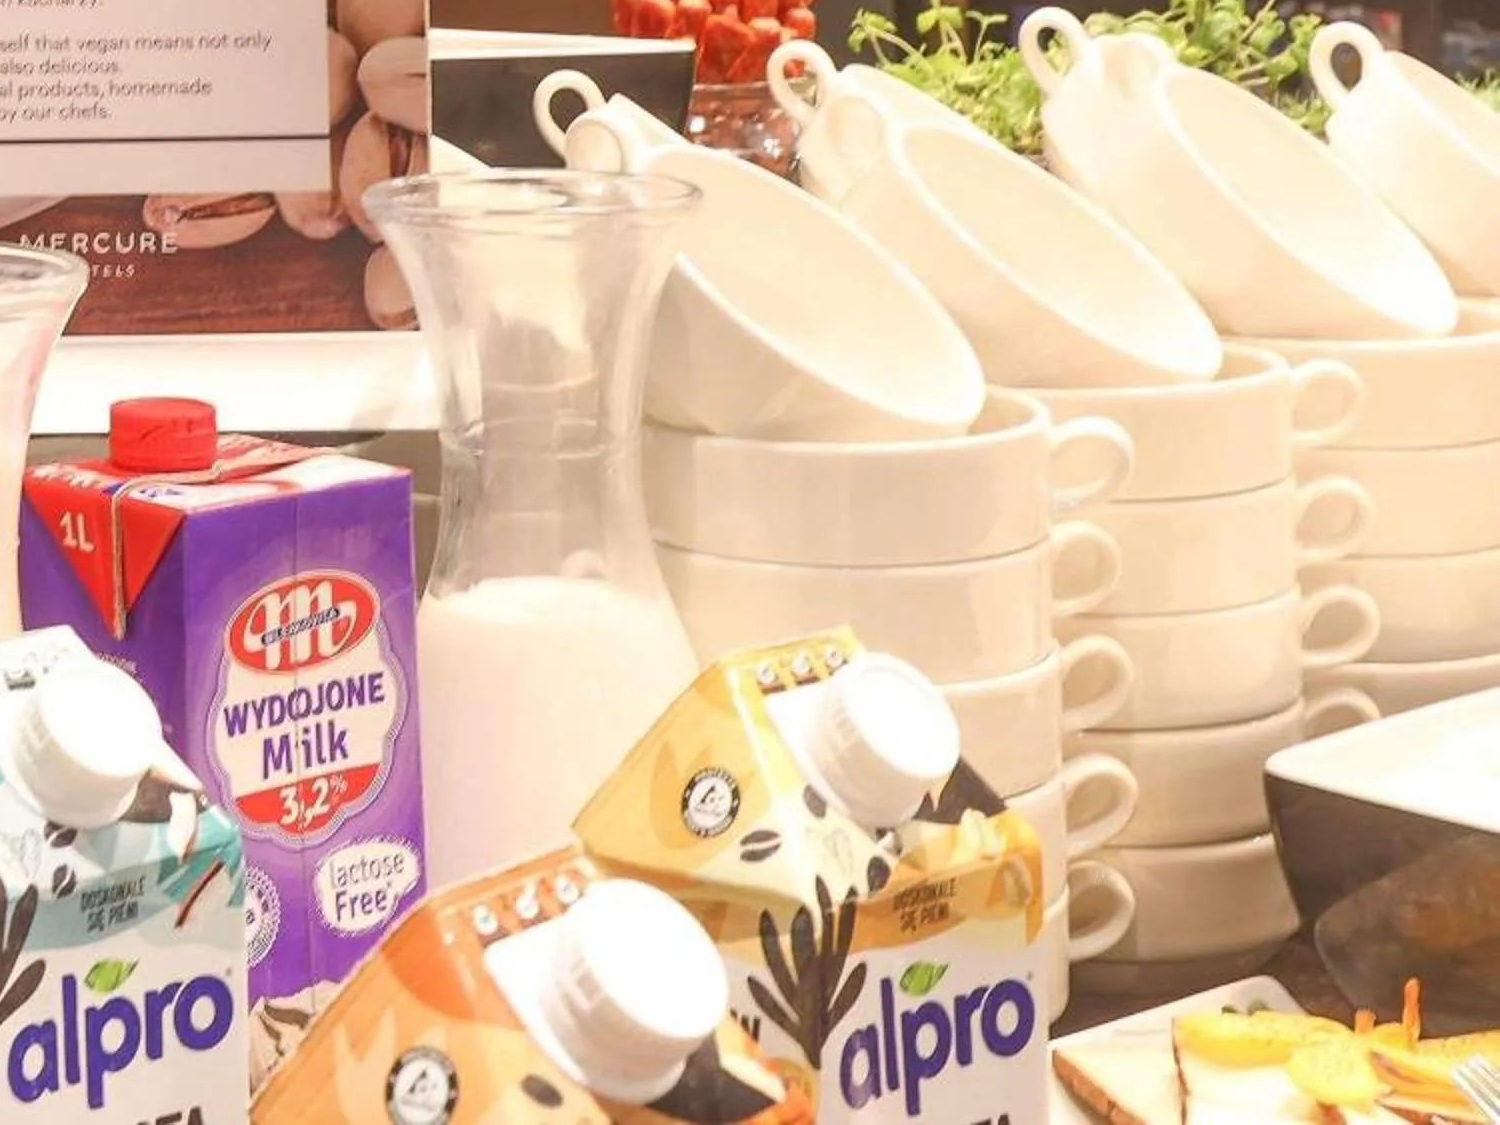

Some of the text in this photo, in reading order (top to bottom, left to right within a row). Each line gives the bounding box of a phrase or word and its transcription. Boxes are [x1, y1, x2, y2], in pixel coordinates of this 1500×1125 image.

[35, 33, 71, 52] that
[76, 35, 130, 55] vegan
[134, 33, 195, 51] means
[199, 31, 228, 49] not
[233, 29, 274, 53] only
[0, 56, 35, 75] also
[109, 76, 213, 97] homemade
[22, 107, 54, 122] our
[18, 231, 179, 255] MERCURE
[91, 264, 137, 279] TELS
[59, 510, 95, 553] 1L
[223, 671, 386, 739] WYDOJONE
[262, 719, 349, 780] Milk
[329, 852, 405, 888] lactose
[334, 888, 387, 922] Free
[7, 974, 234, 1109] alpro
[839, 977, 1036, 1117] alpro
